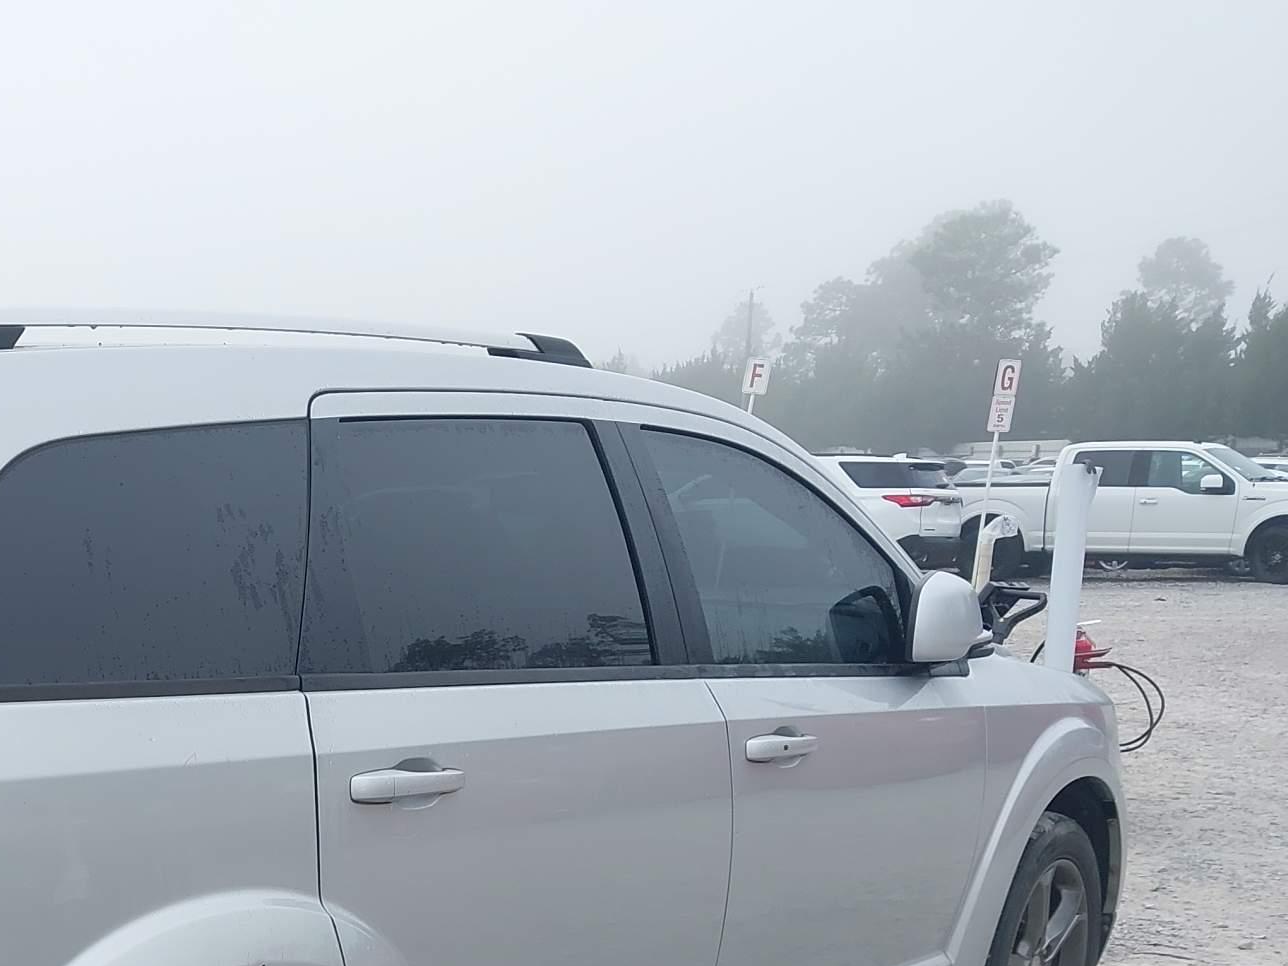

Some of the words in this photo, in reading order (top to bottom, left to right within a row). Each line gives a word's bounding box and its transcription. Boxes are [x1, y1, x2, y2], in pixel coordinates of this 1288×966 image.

[749, 363, 765, 388] F
[1000, 364, 1016, 391] G
[996, 413, 1004, 423] 5
